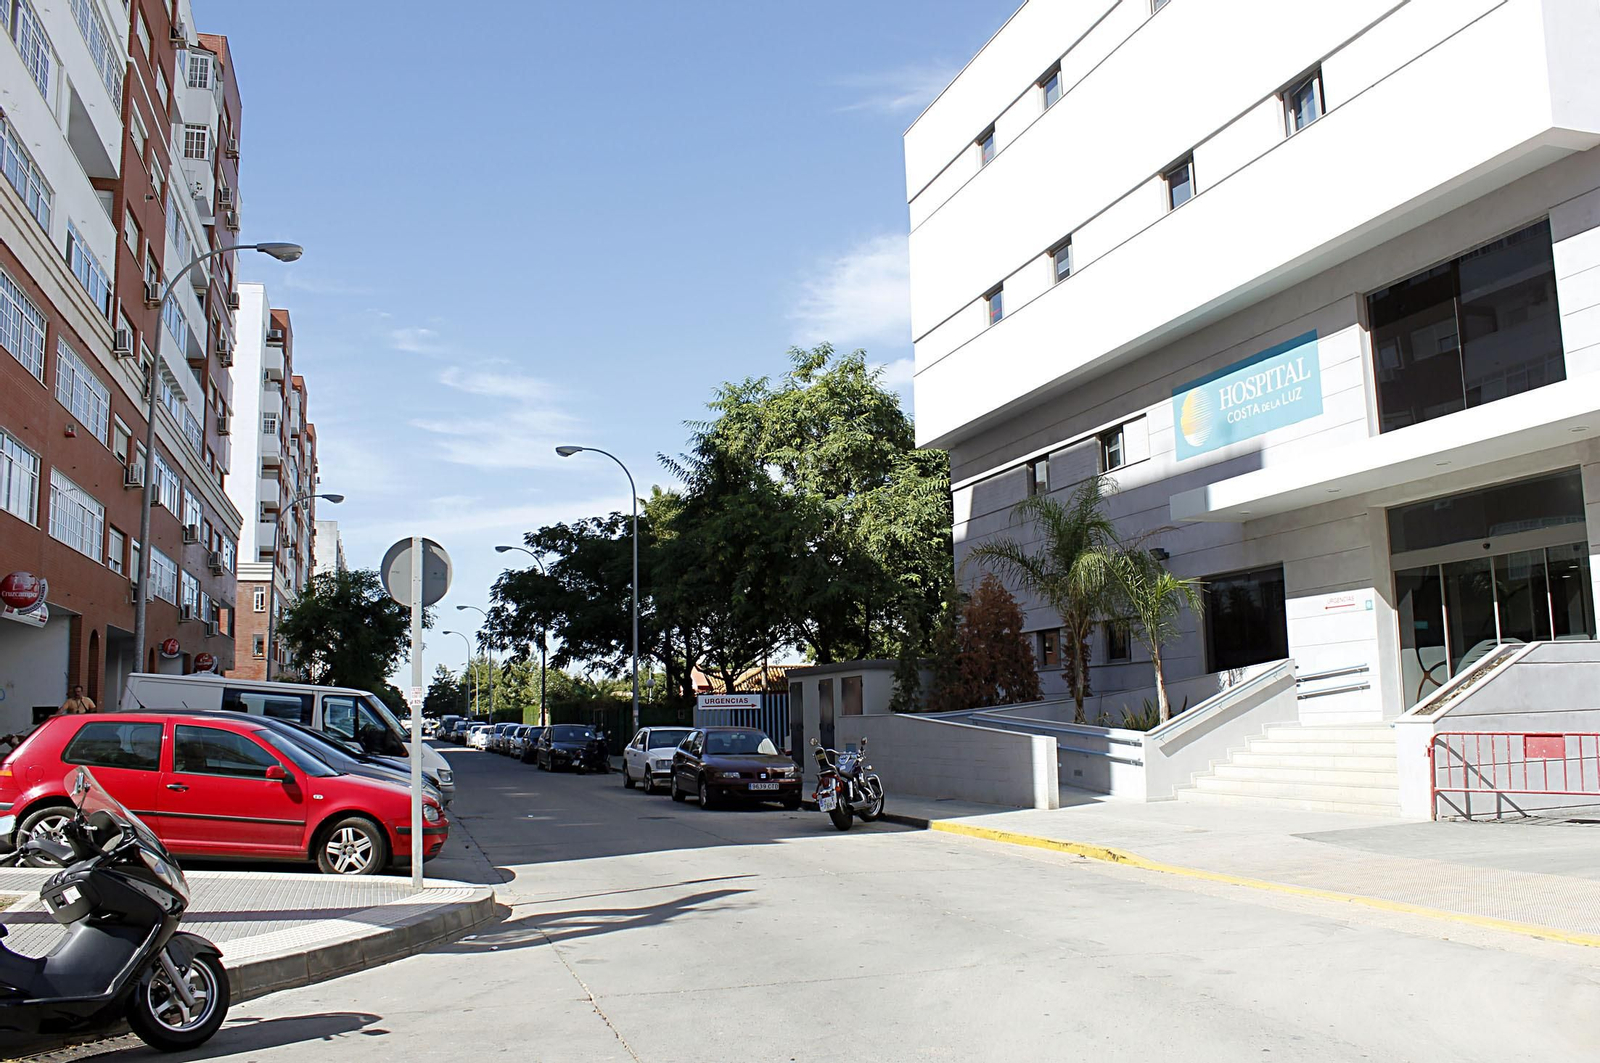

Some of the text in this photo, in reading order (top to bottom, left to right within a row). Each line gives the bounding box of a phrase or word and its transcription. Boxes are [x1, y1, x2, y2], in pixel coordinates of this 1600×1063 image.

[1219, 357, 1311, 411] HOSPITAL
[1227, 403, 1260, 424] COSTA
[1281, 387, 1303, 406] LUZ
[1327, 595, 1355, 604] URGENCIAS
[704, 697, 749, 705] URGENCIAS
